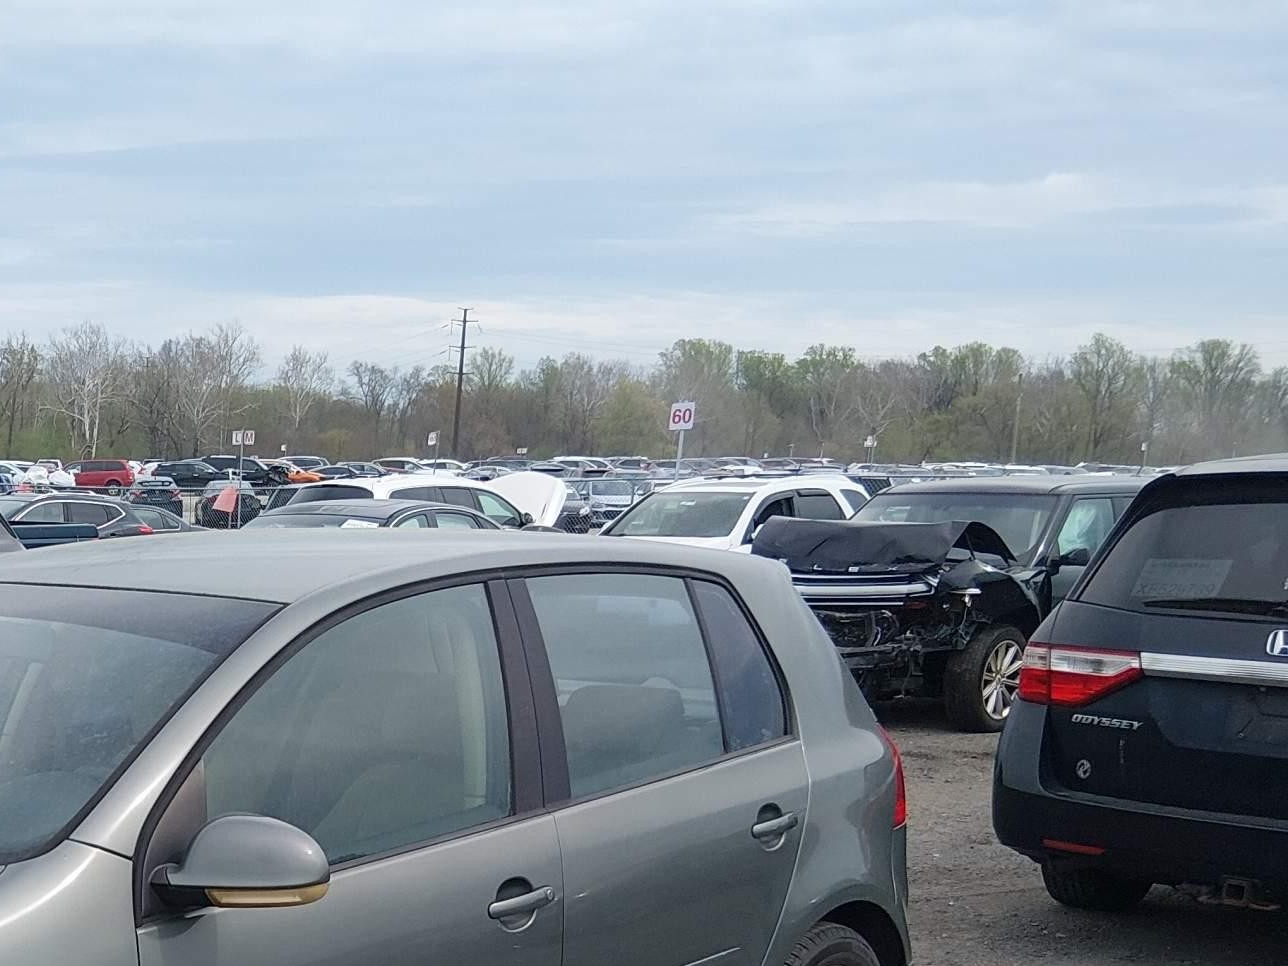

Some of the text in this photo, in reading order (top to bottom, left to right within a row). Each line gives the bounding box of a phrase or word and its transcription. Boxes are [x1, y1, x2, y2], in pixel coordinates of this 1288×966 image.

[672, 408, 692, 424] 60
[235, 432, 241, 443] L
[245, 432, 253, 443] M
[1072, 713, 1143, 730] ODYSSEY
